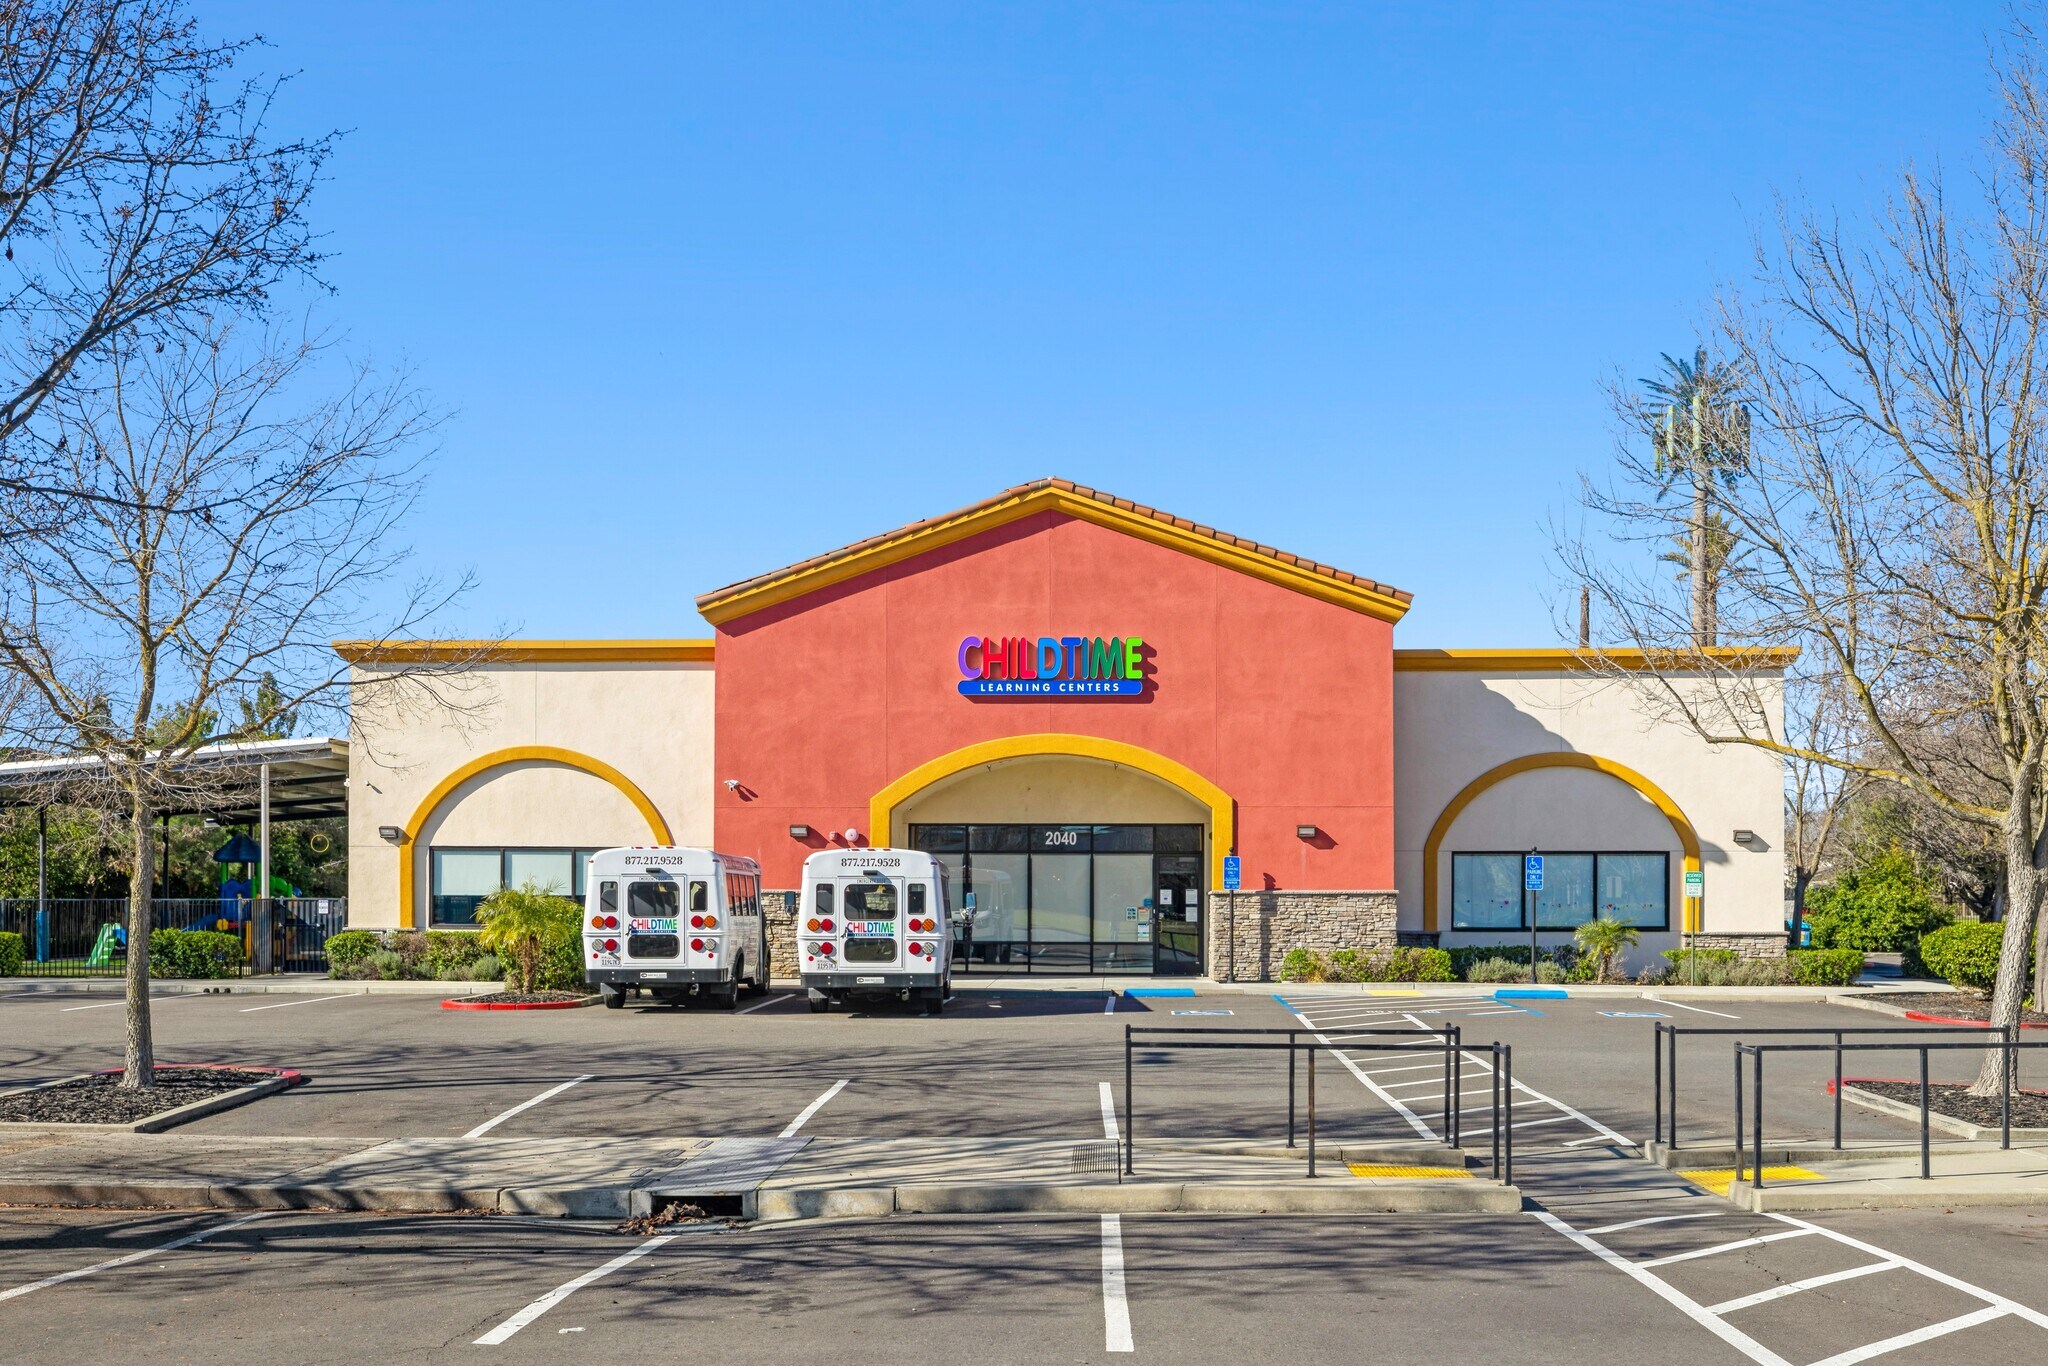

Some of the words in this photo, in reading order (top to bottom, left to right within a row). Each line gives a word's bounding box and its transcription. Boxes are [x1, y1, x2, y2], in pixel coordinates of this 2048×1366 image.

[958, 636, 1143, 680] CHILDTIME
[980, 683, 1051, 692] LEARNING
[1059, 683, 1120, 692] CENTERS
[1045, 831, 1077, 845] 2040
[625, 856, 683, 865] 877.217.9528
[841, 858, 901, 867] 877.217.9528
[631, 919, 677, 930] CHILDTIME
[847, 922, 894, 933] CHILDTIME
